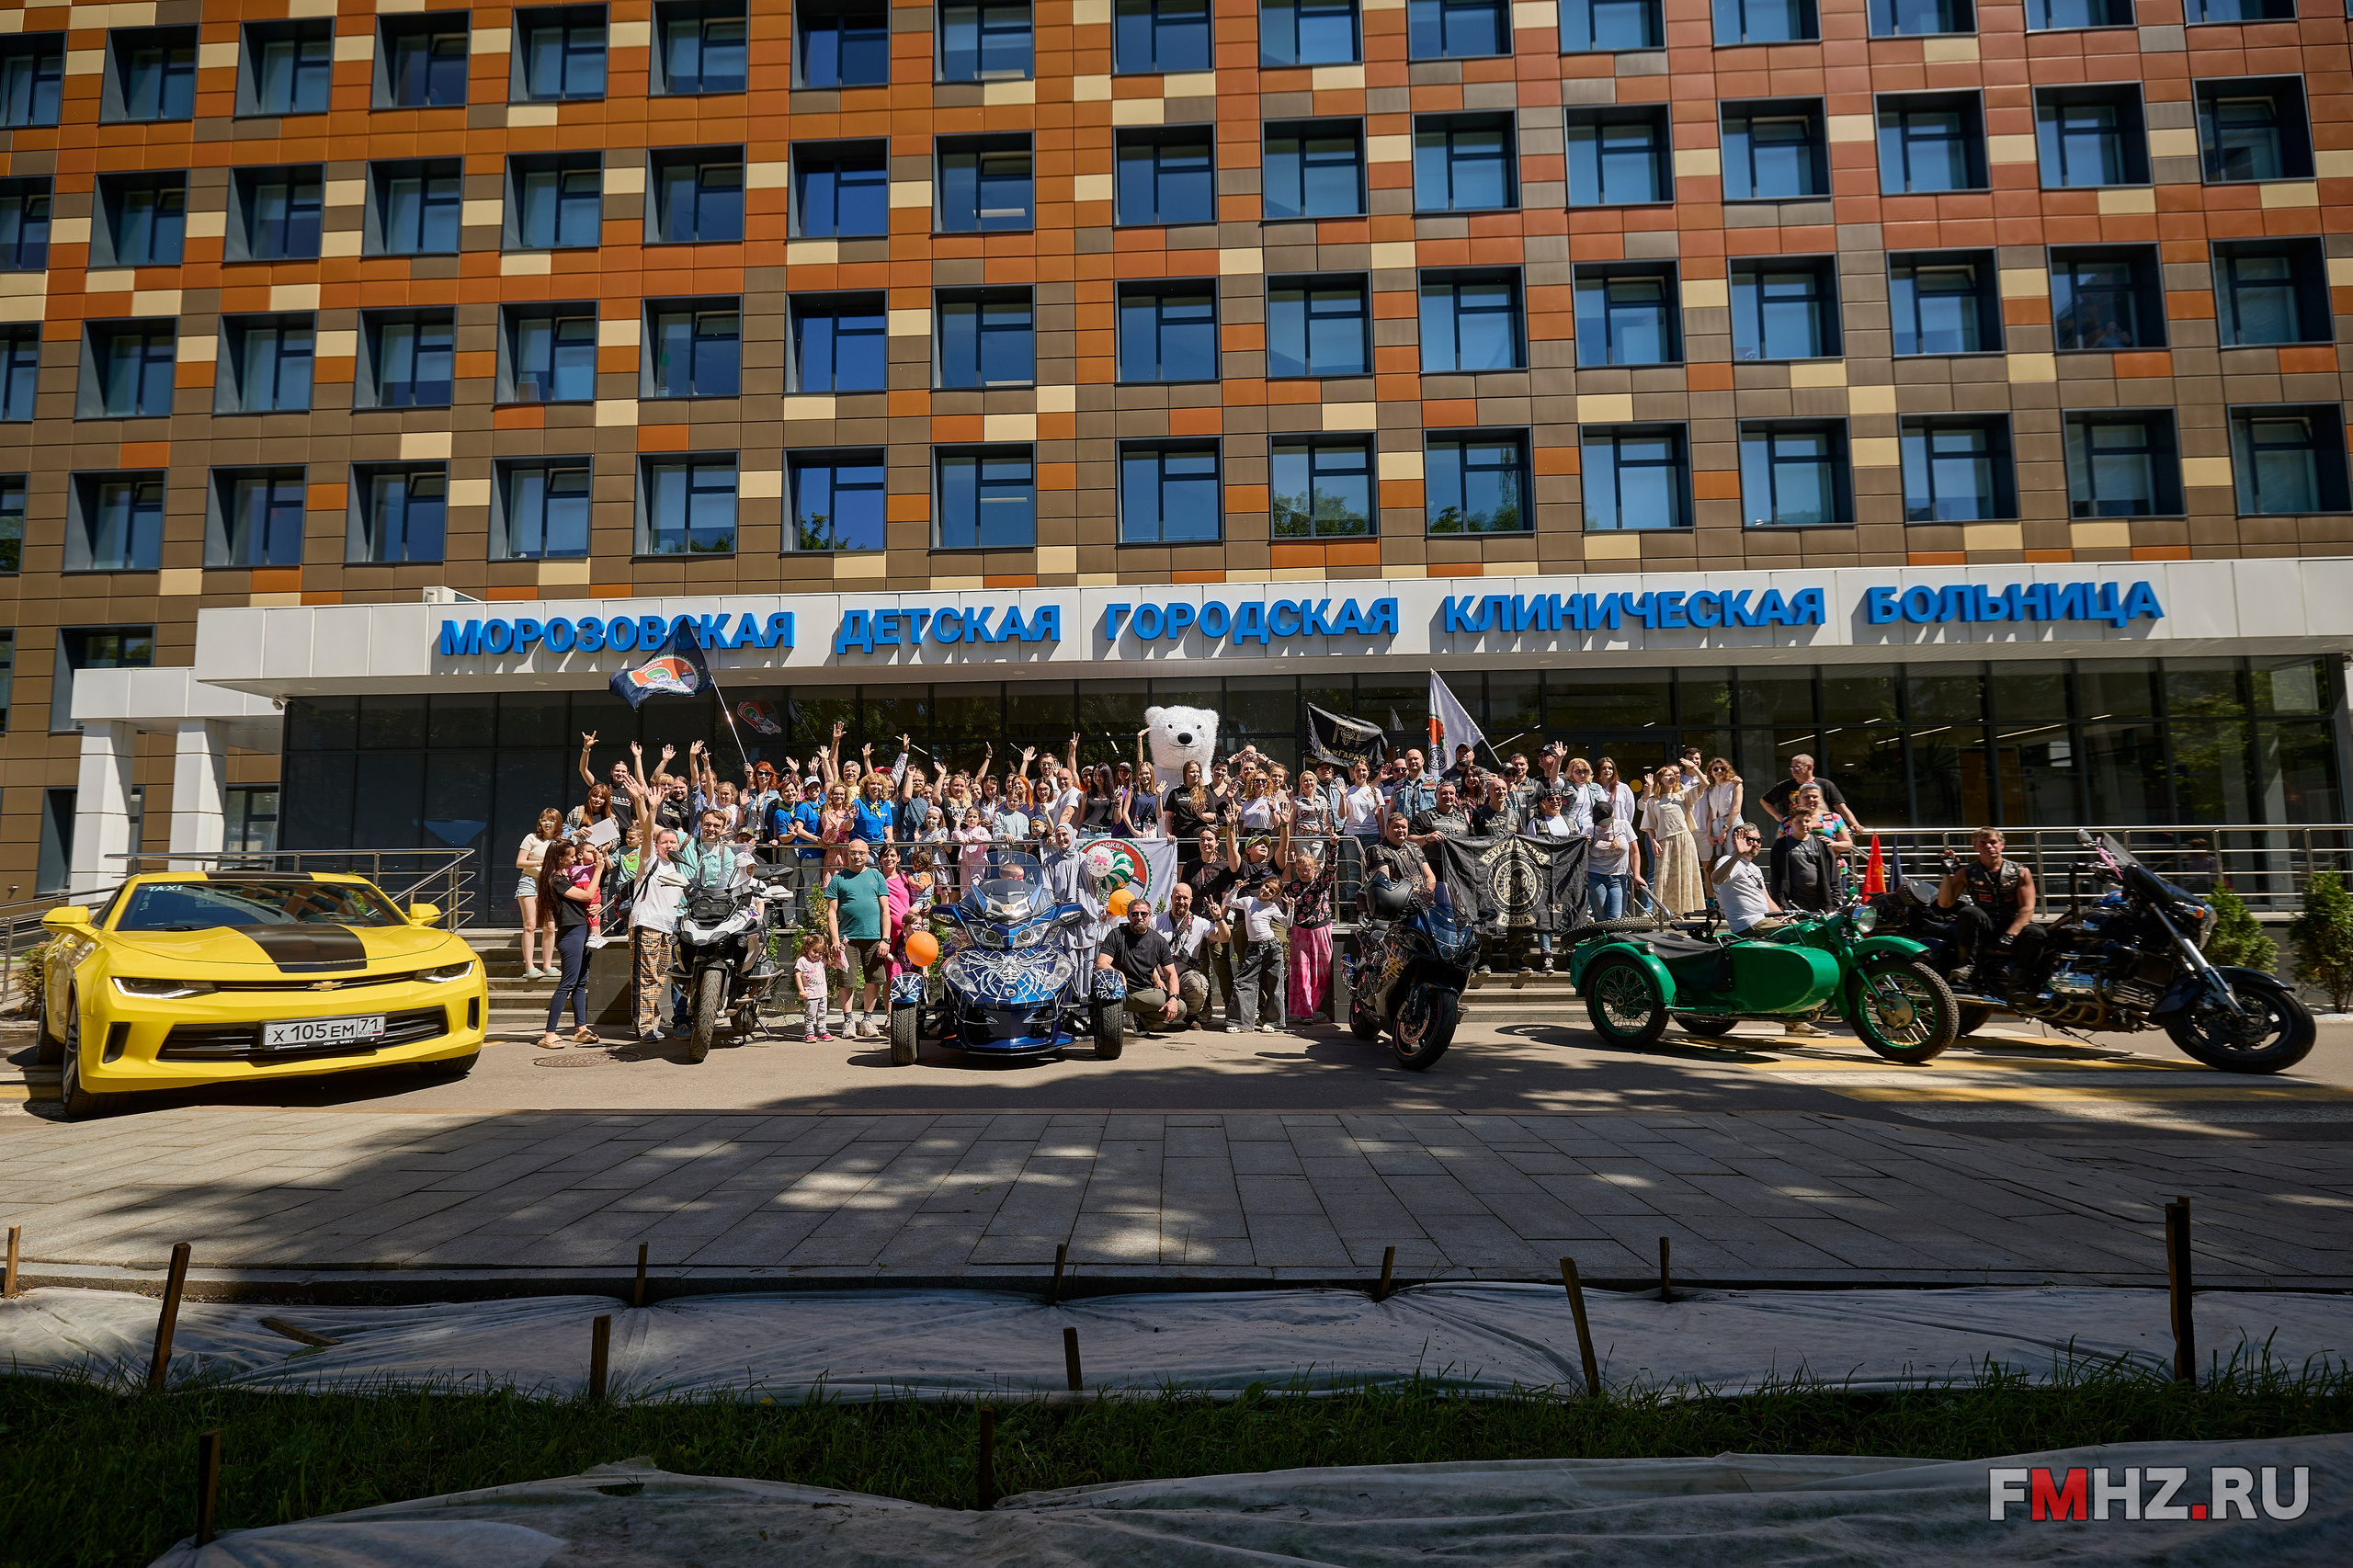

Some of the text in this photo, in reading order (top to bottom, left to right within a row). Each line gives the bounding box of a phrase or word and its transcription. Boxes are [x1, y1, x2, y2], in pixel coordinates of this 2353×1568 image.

[835, 604, 1062, 654] ДЕТСКАЯ
[1106, 597, 1399, 645] ГОРОДСКАЯ
[1444, 587, 1826, 632] КЛИНИЧЕСКАЯ
[1868, 581, 2165, 628] БОЛЬНИЦА
[1094, 841, 1125, 851] ОСКВА
[1483, 841, 1545, 862] SEVEN ROADS
[1501, 915, 1531, 925] RUSSIA
[360, 1018, 378, 1030] 71
